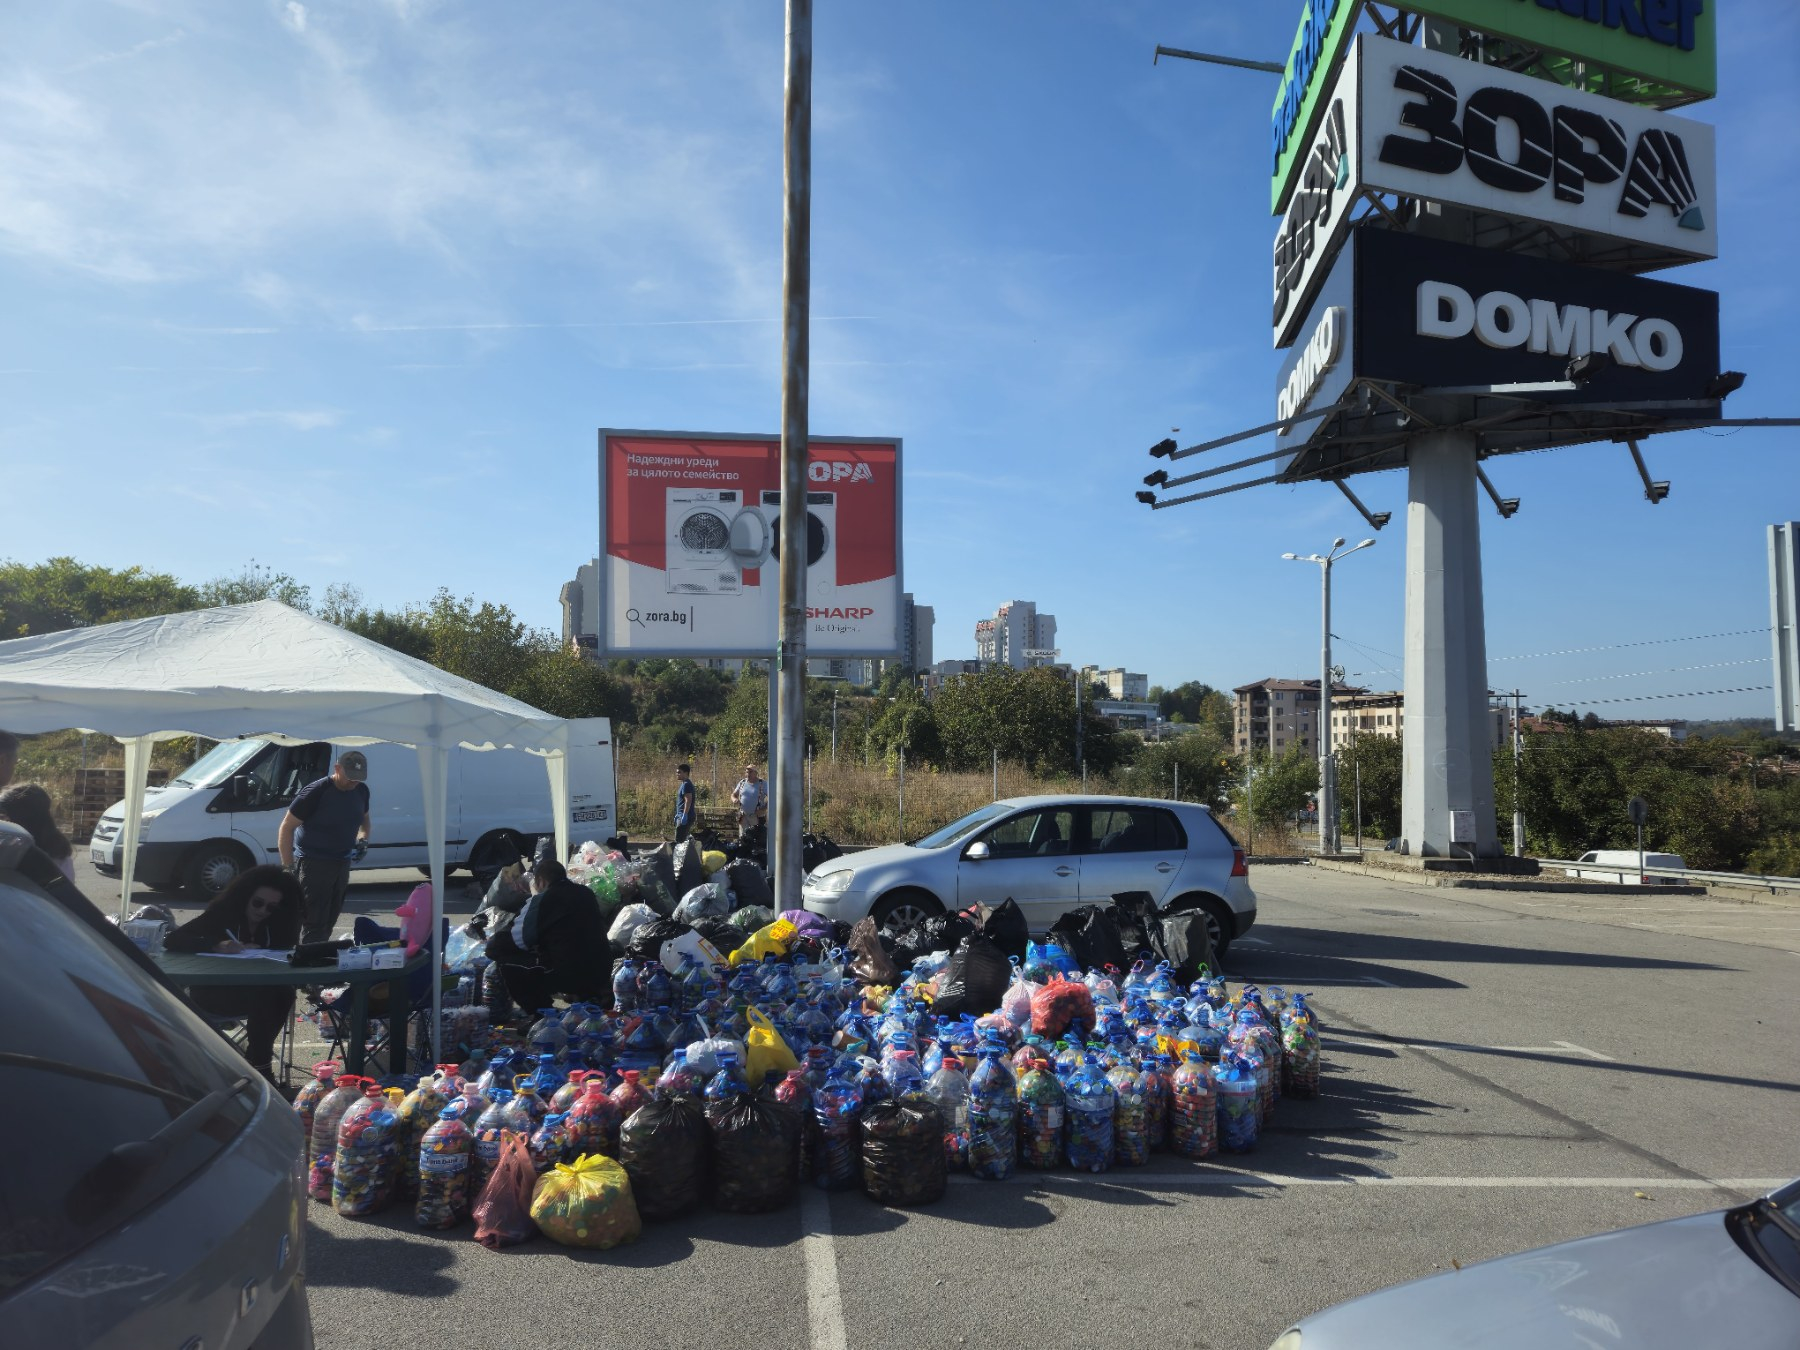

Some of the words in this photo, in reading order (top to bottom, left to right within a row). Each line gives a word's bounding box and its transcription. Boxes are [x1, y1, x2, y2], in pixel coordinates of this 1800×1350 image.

[1379, 64, 1704, 231] ЗОРА
[1416, 279, 1684, 372] DOMKO
[1277, 305, 1346, 436] DOMKO
[627, 453, 685, 468] Надеждни
[686, 455, 720, 468] уреди
[627, 469, 640, 478] за
[642, 469, 681, 480] цялото
[683, 468, 740, 481] семейство
[808, 461, 875, 484] ОРА
[645, 609, 687, 625] zora.bg
[805, 607, 875, 620] SHARP
